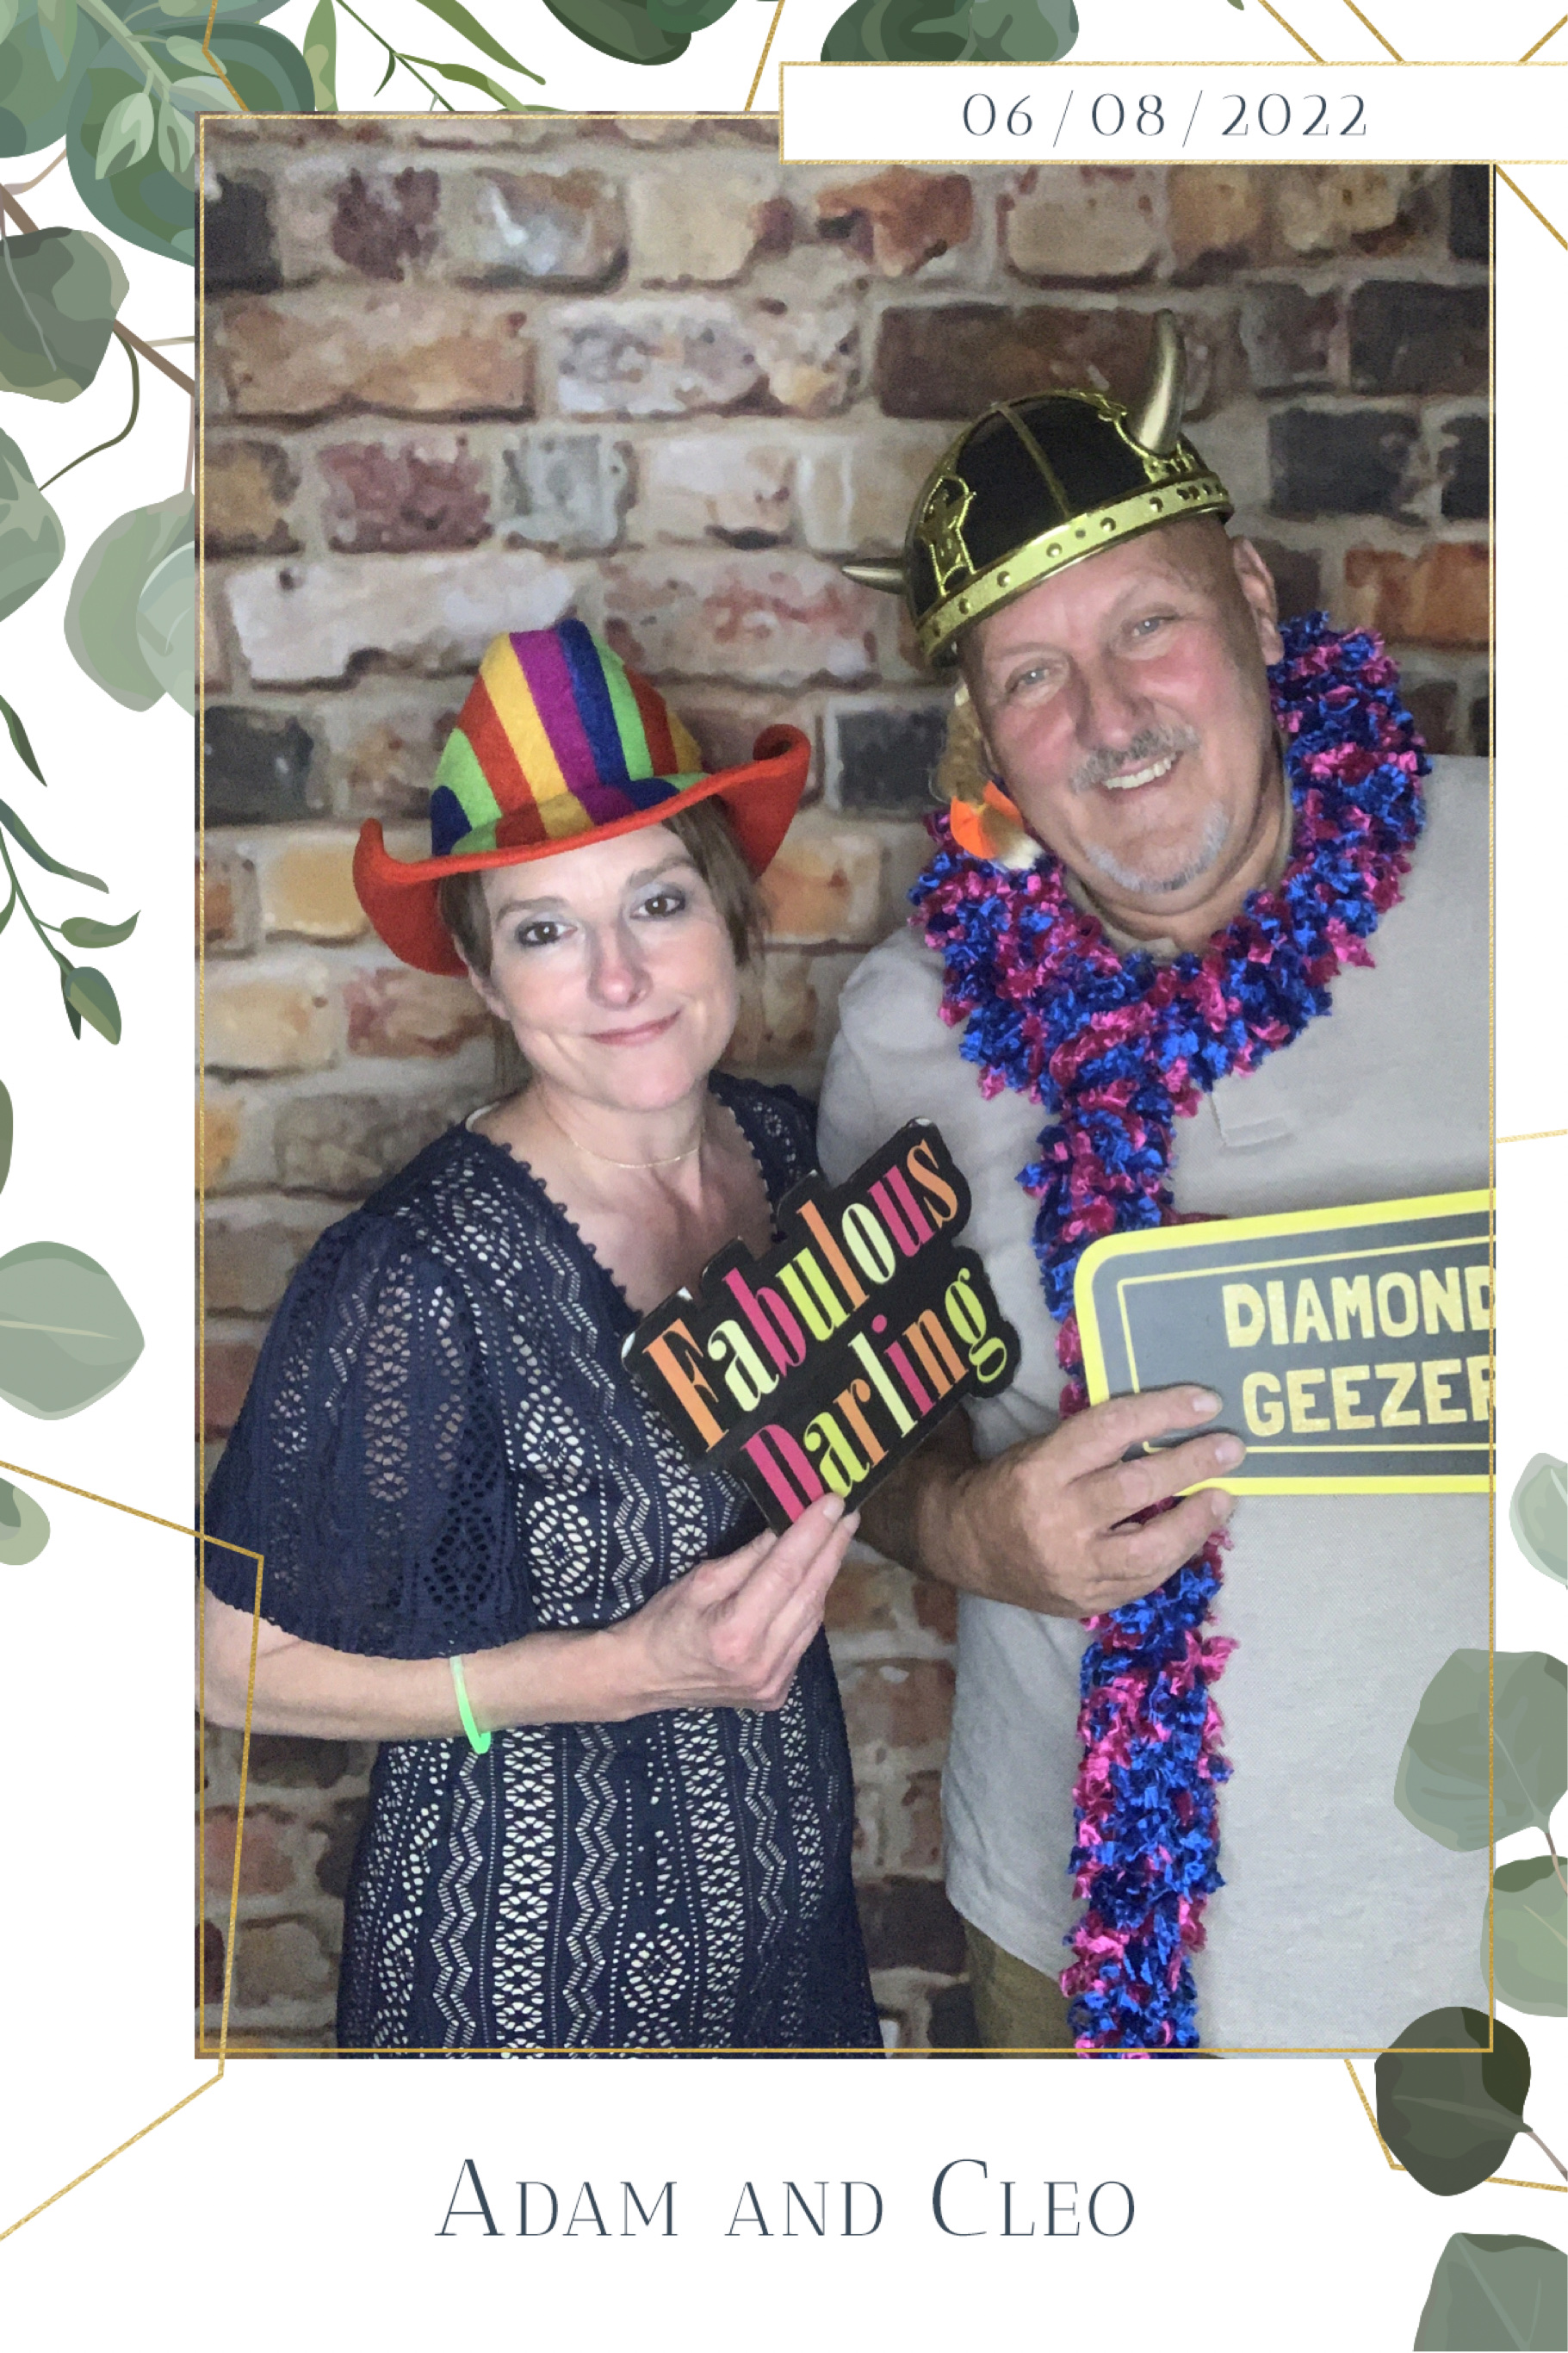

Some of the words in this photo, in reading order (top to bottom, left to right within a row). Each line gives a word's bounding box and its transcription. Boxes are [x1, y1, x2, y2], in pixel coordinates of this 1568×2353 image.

[642, 1139, 958, 1453] Fabulous
[740, 1267, 1007, 1524] Darling
[1222, 1265, 1497, 1348] DIAMOND
